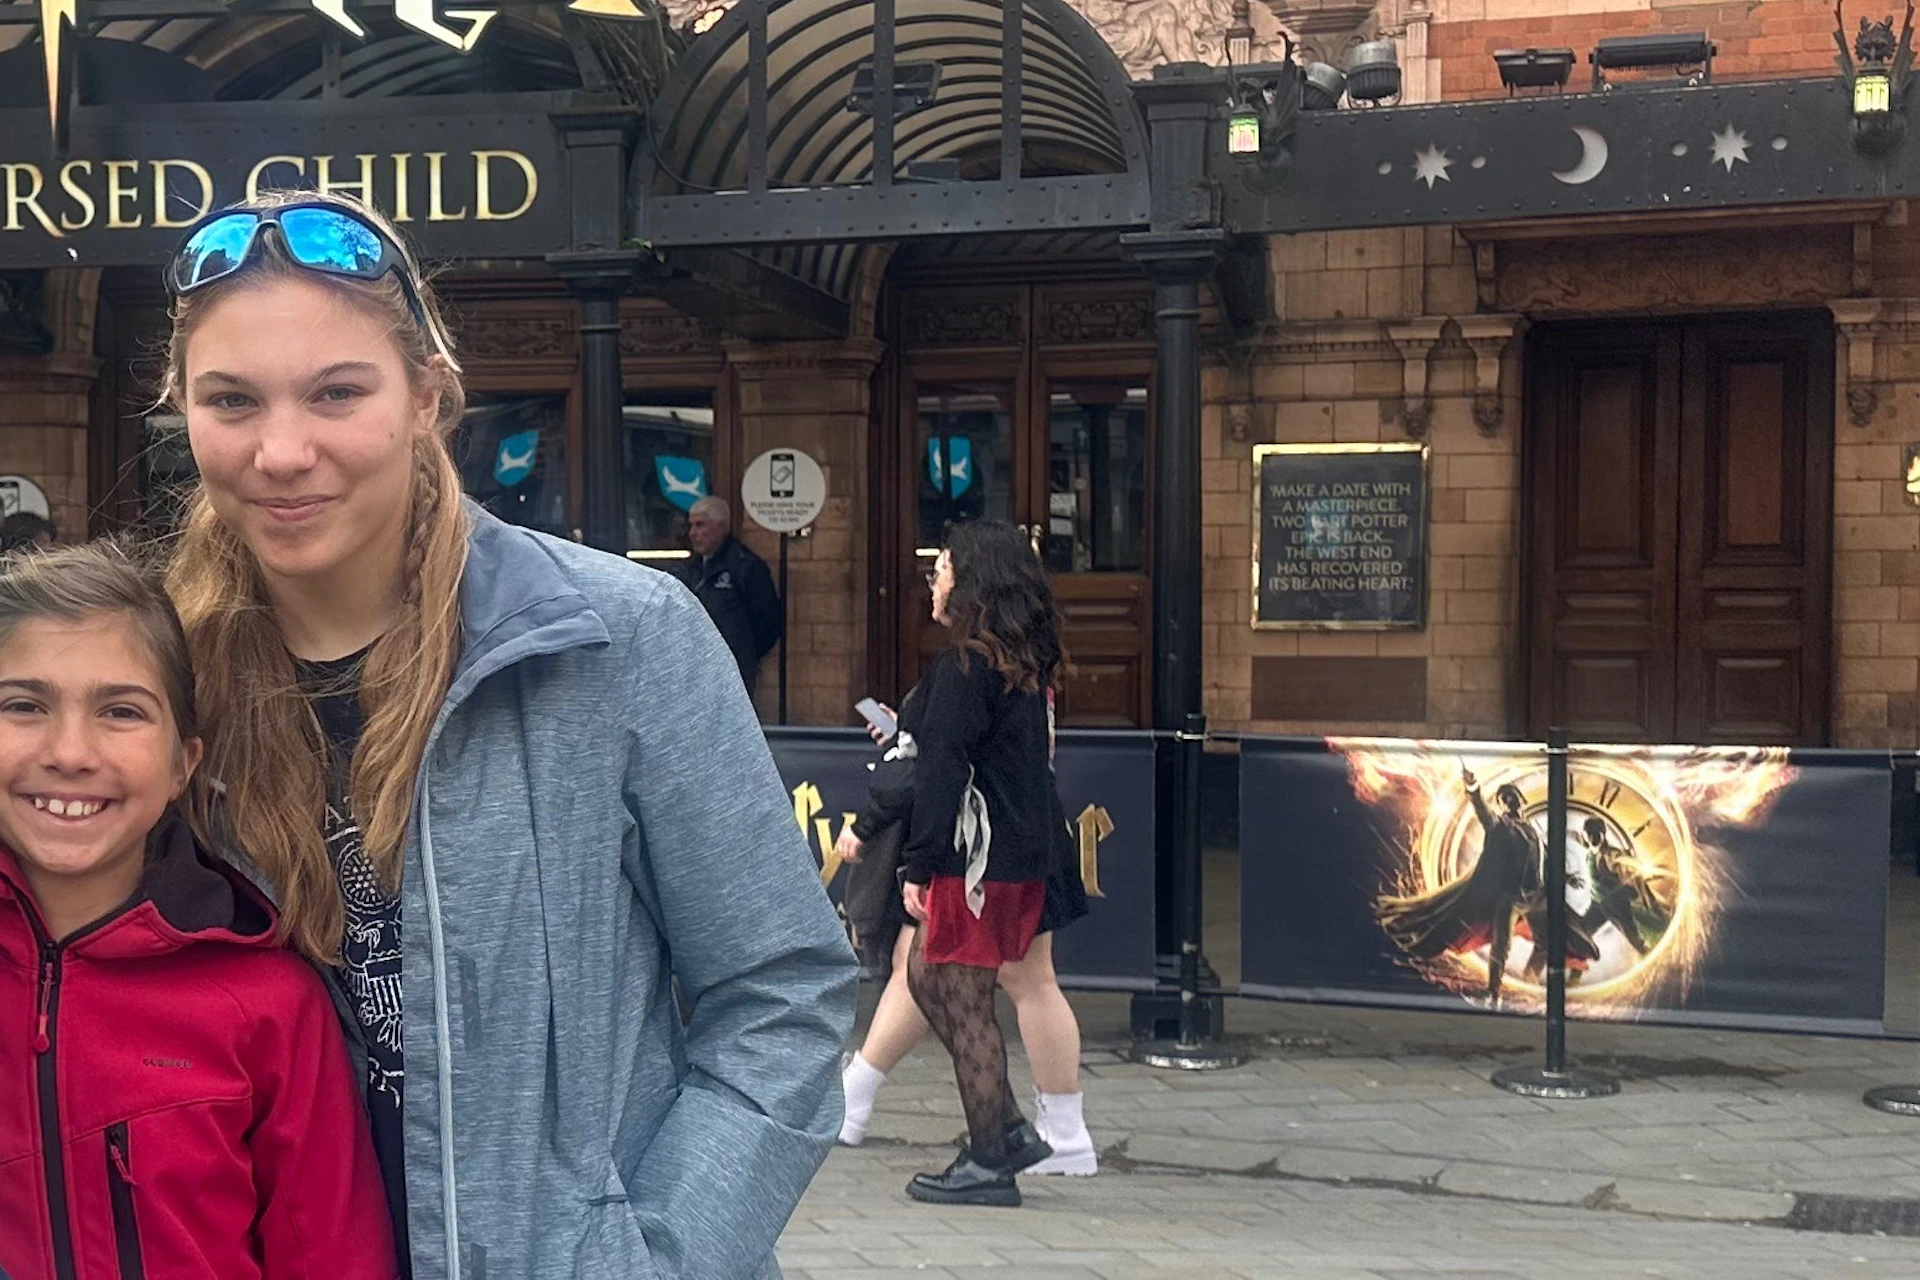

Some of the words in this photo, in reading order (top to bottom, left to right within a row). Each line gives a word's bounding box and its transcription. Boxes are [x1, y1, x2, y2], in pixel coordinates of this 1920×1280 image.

[246, 150, 540, 222] CHILD
[1318, 484, 1330, 497] A
[1332, 483, 1370, 497] DATE
[1373, 482, 1412, 496] WITH
[1282, 500, 1293, 513] A
[1272, 515, 1305, 528] TWO
[1351, 514, 1409, 528] POTTER
[1291, 530, 1325, 544] EPIC
[1327, 531, 1340, 544] IS
[1285, 546, 1314, 559] THE
[1317, 546, 1357, 559] WEST
[1360, 546, 1393, 559] END
[1277, 562, 1307, 575] HAS
[1311, 561, 1403, 575] RECOVERED
[1292, 577, 1356, 591] BEATING
